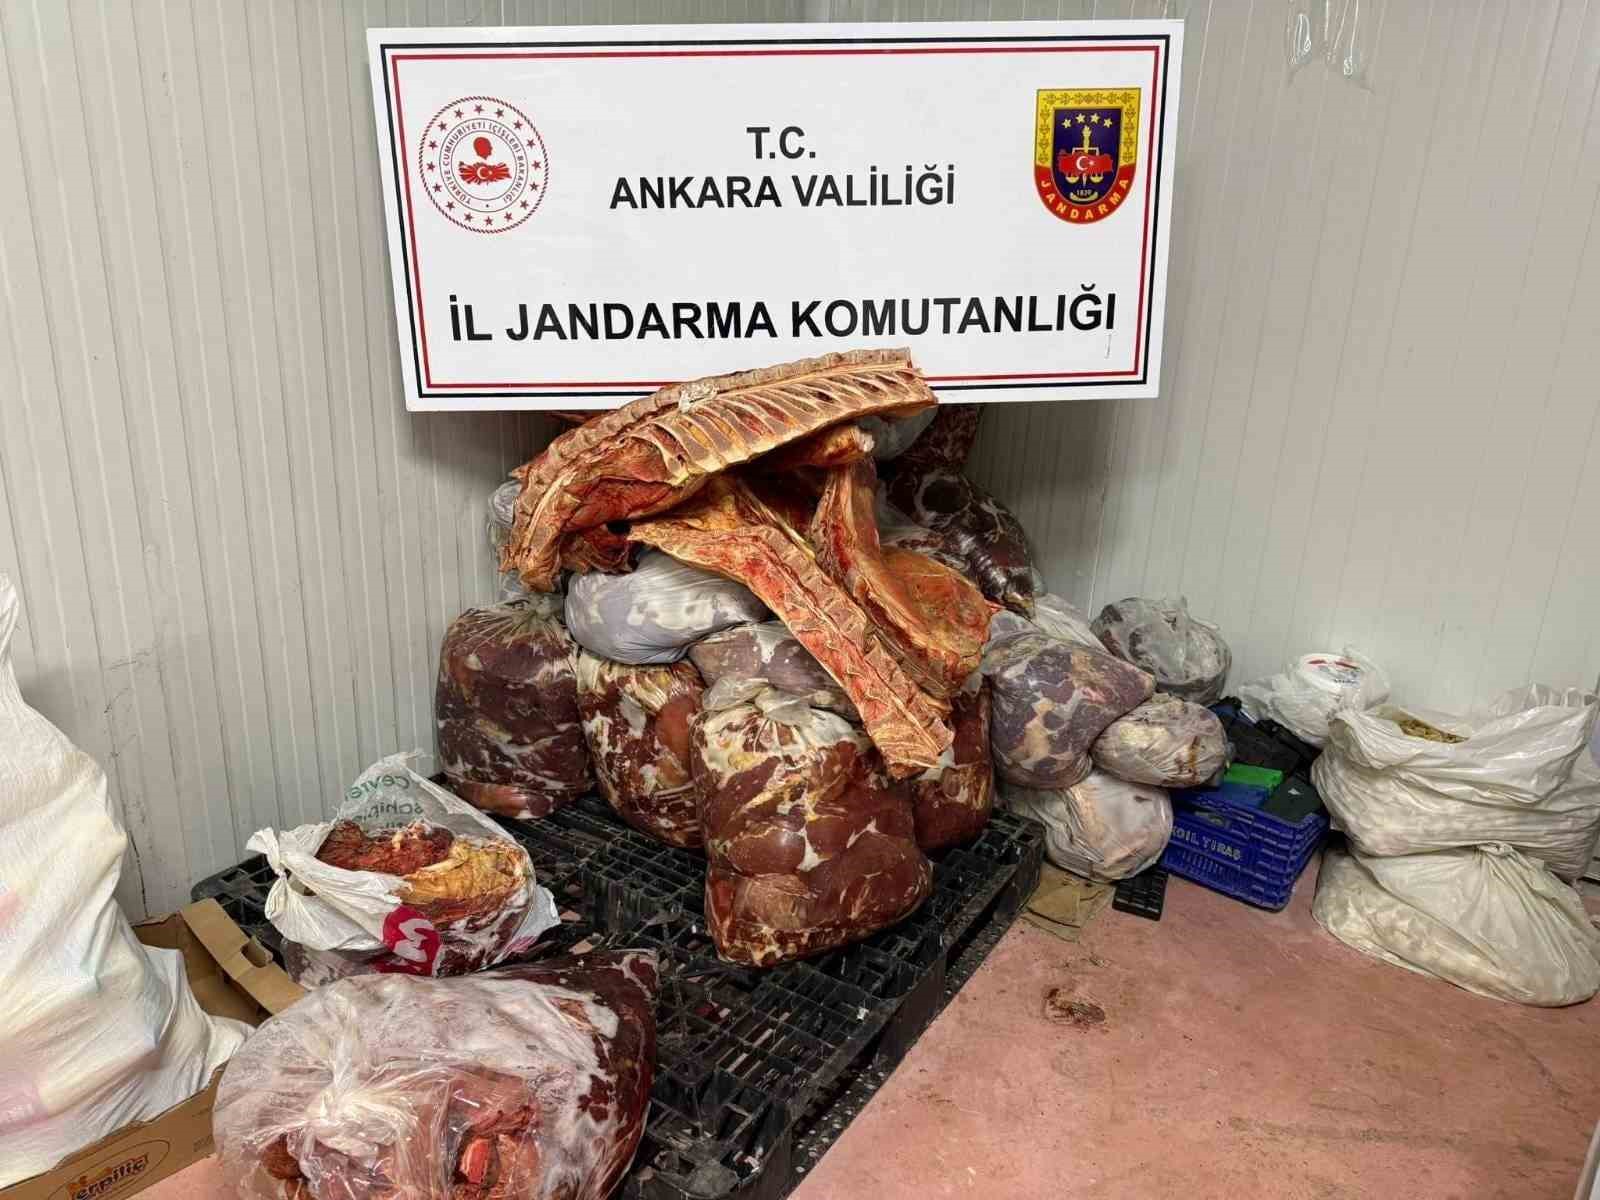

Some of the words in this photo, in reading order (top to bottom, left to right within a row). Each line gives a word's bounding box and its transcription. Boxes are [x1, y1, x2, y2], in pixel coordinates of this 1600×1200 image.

[746, 126, 816, 160] T.C.
[609, 176, 782, 209] ANKARA
[791, 164, 954, 207] VALİLİĞİ
[1041, 179, 1129, 220] JANDARMA
[449, 294, 493, 341] İL
[505, 301, 778, 341] JANDARMA
[791, 283, 1116, 338] KOMUTANLIĞI
